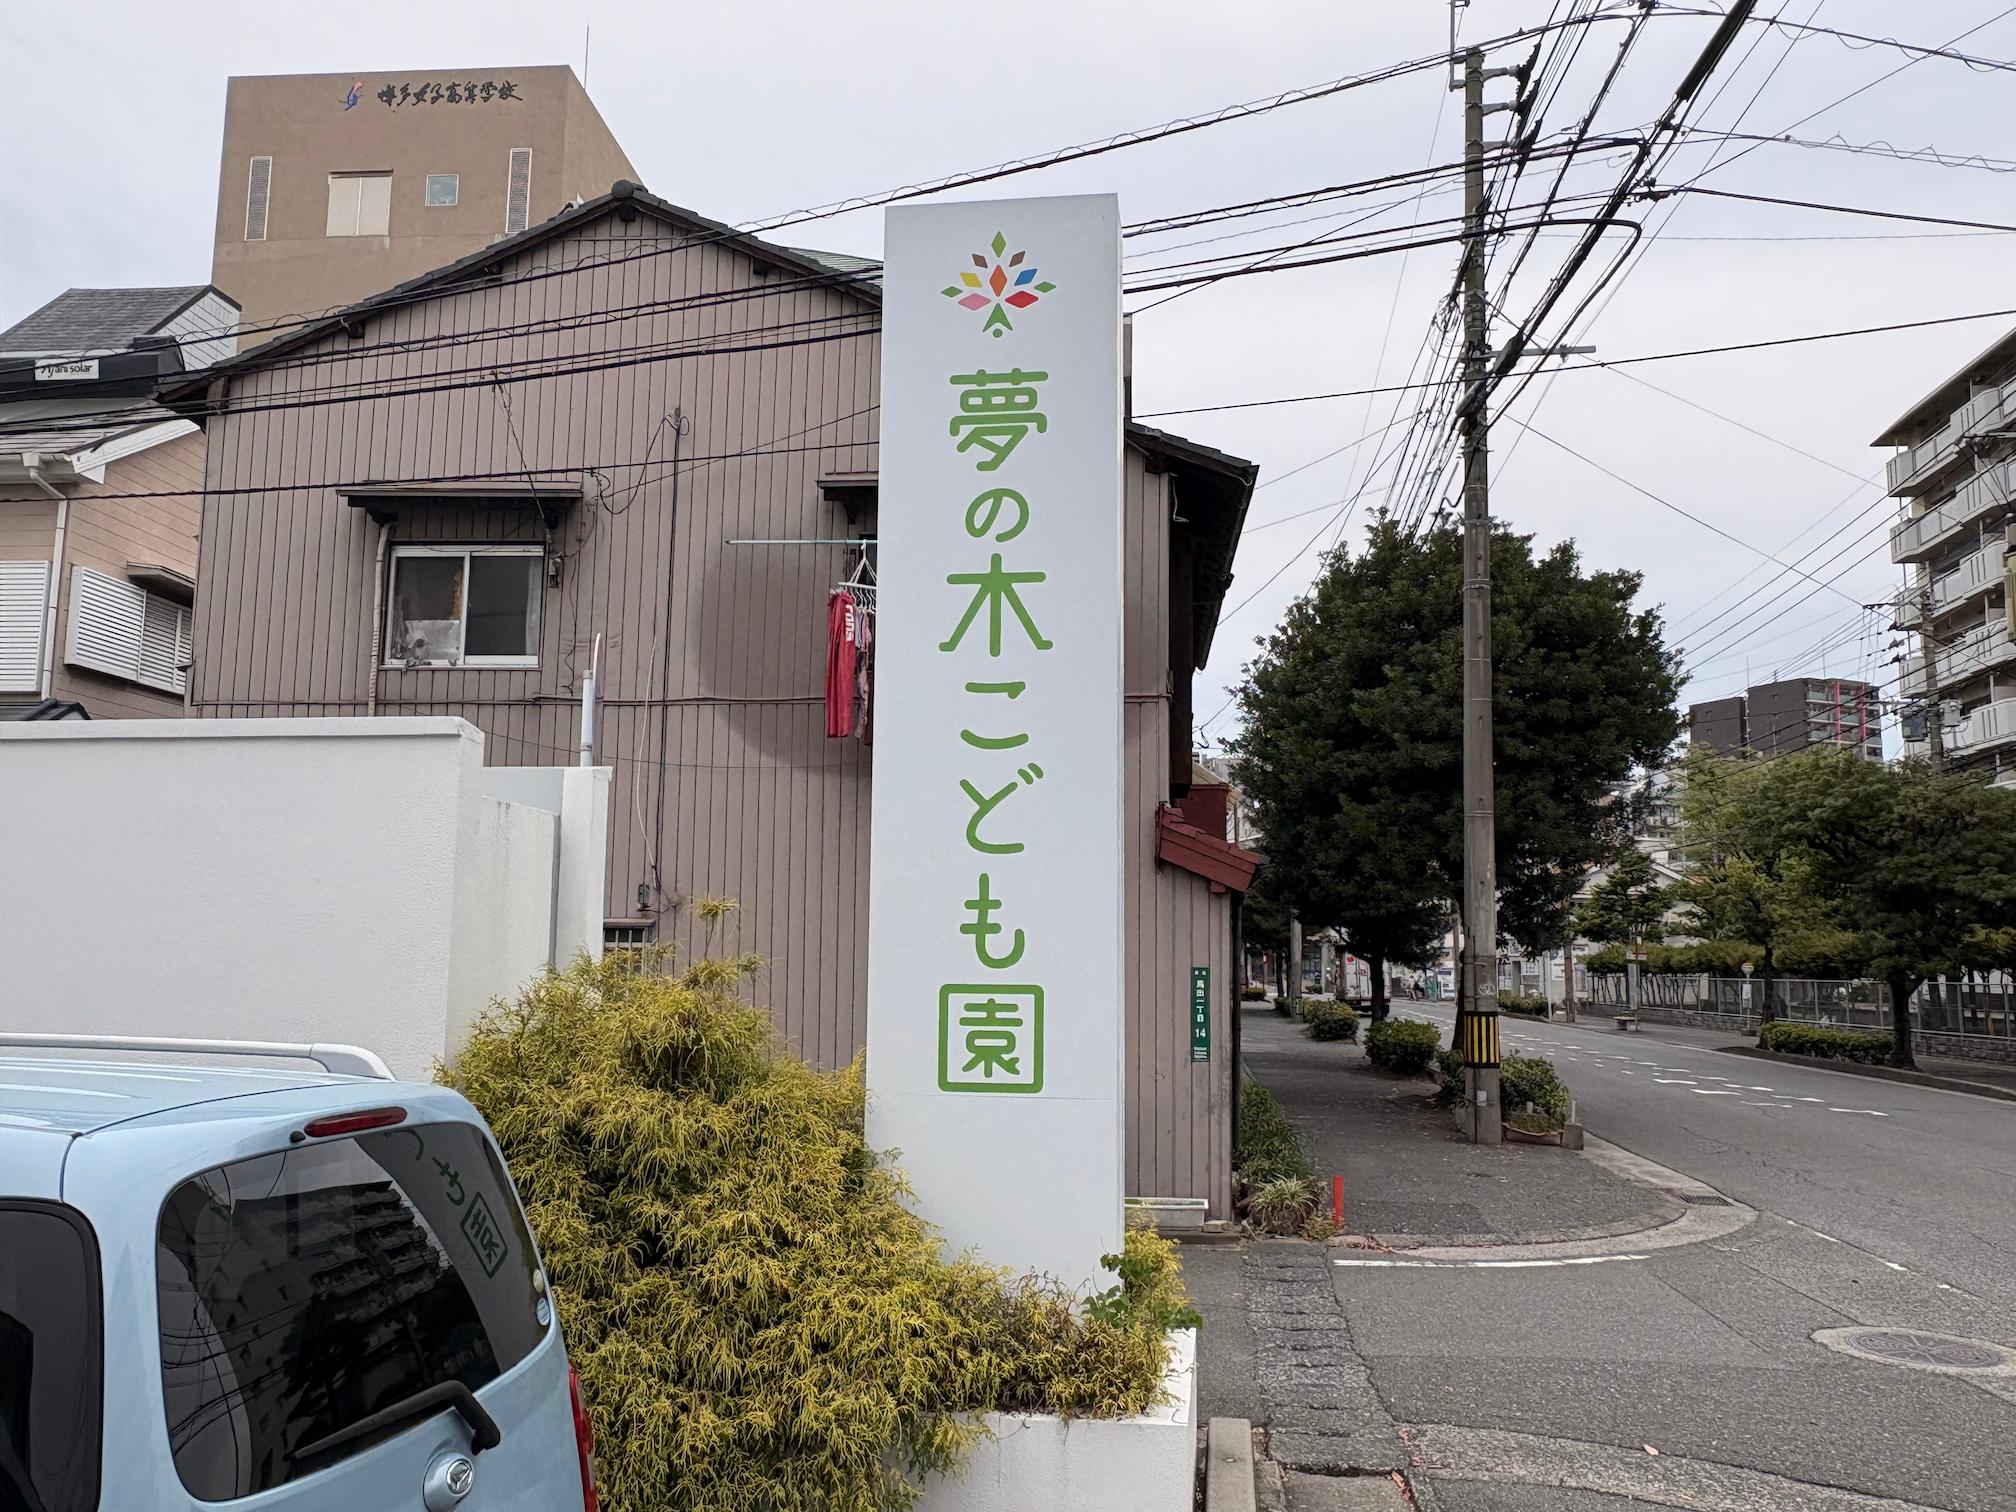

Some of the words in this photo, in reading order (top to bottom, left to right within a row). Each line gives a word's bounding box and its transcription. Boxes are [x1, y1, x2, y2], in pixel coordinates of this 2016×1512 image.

[70, 363, 93, 374] solar
[938, 368, 1053, 1094] 夢の木こども園
[1195, 1028, 1206, 1038] 14
